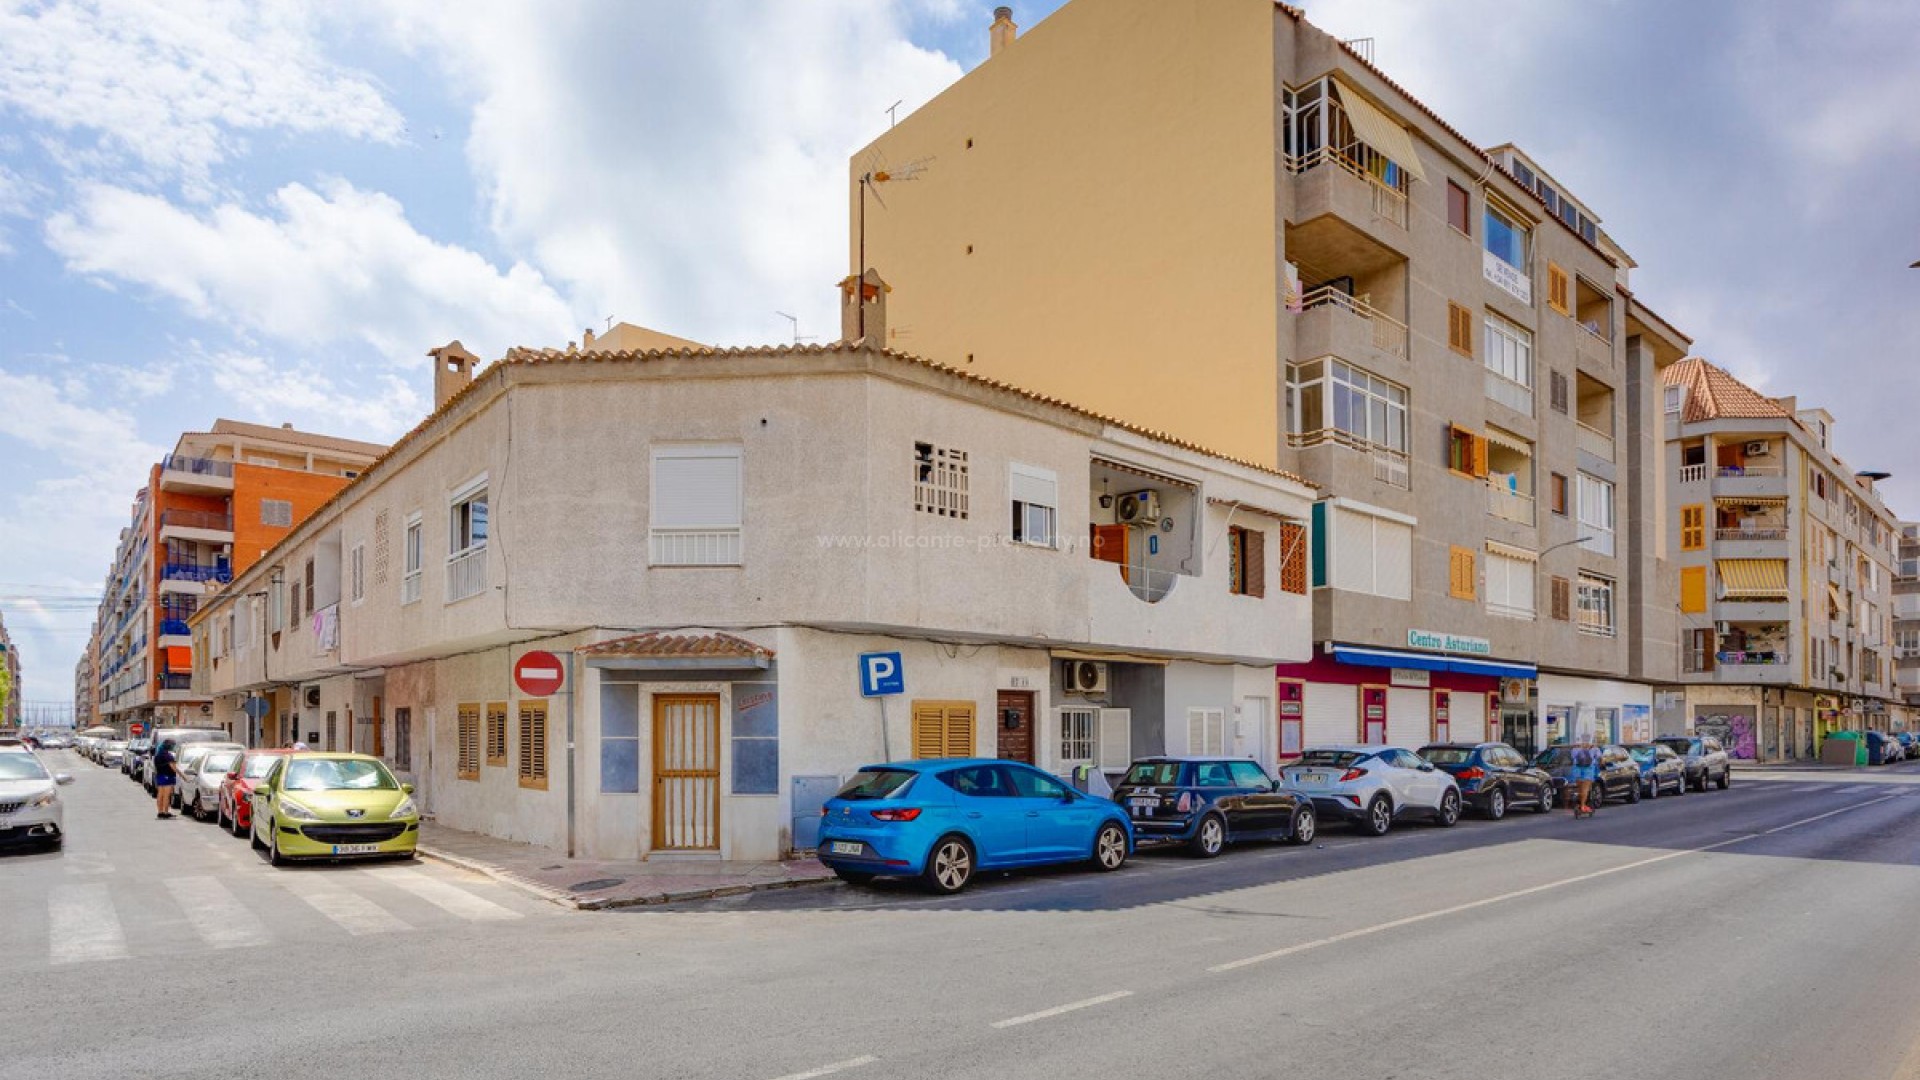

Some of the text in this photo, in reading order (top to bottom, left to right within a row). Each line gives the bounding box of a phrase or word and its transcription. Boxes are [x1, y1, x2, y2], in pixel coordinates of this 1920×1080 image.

[1410, 630, 1489, 653] Centro Asturiano
[869, 657, 894, 691] P
